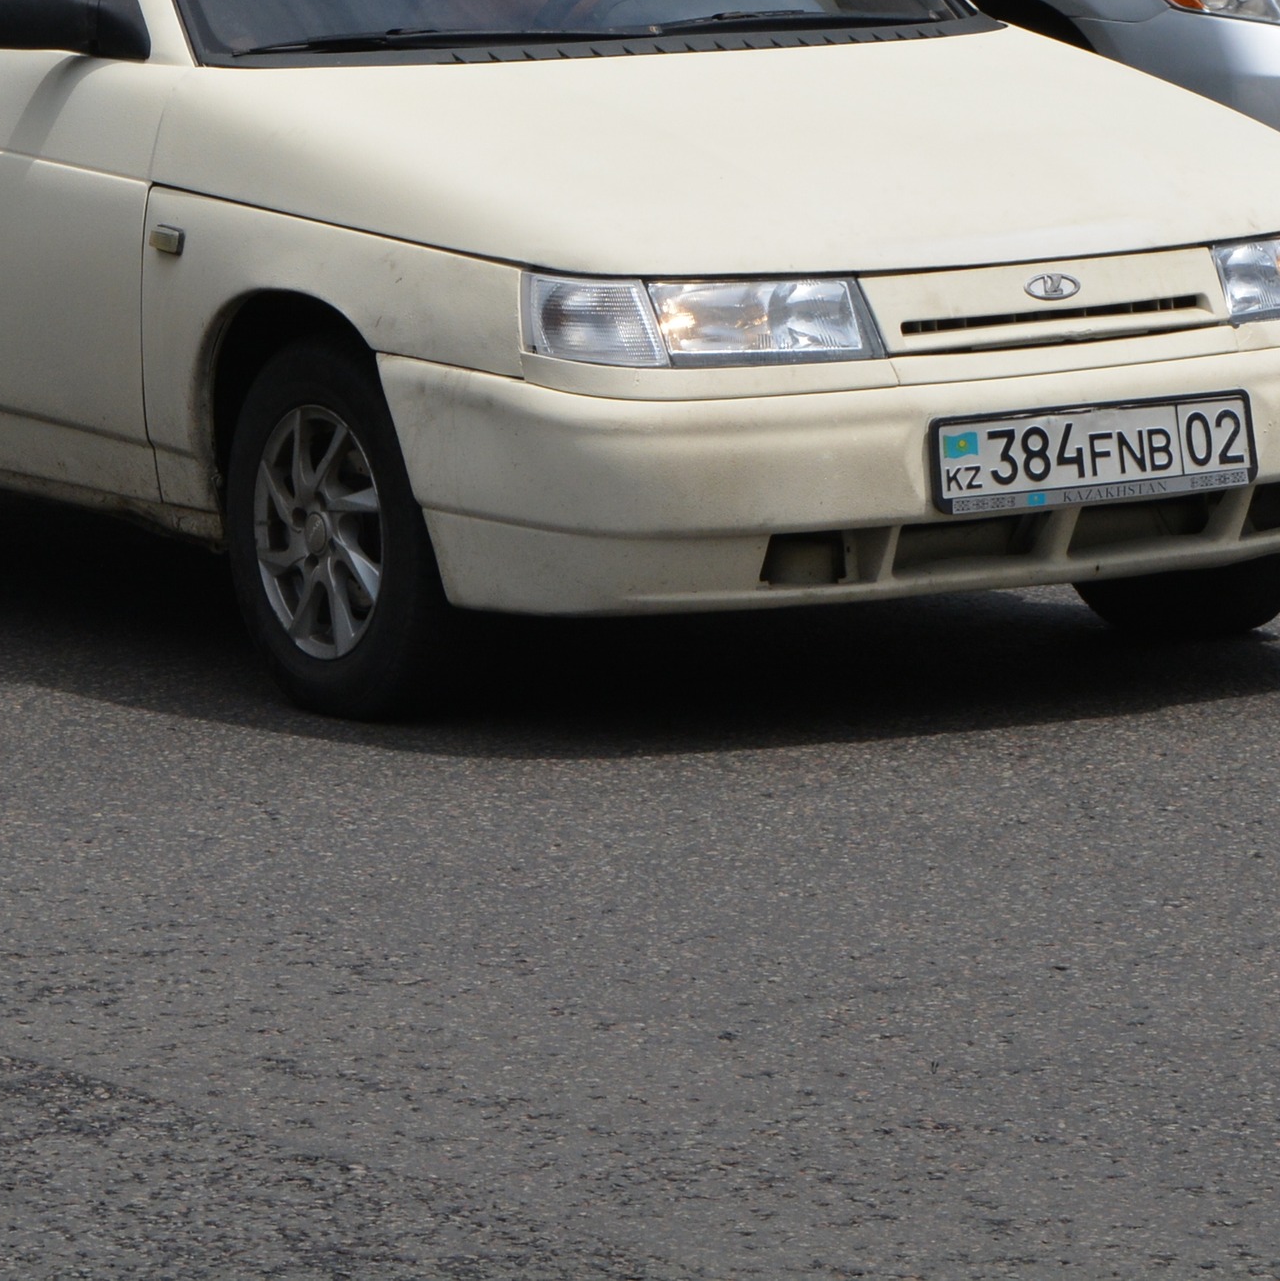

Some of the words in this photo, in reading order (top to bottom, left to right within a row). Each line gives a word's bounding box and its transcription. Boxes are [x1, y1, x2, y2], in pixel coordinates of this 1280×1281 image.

[945, 465, 983, 493] KZ
[1185, 408, 1245, 467] 02
[1062, 480, 1168, 503] KAZAKHSTAN
